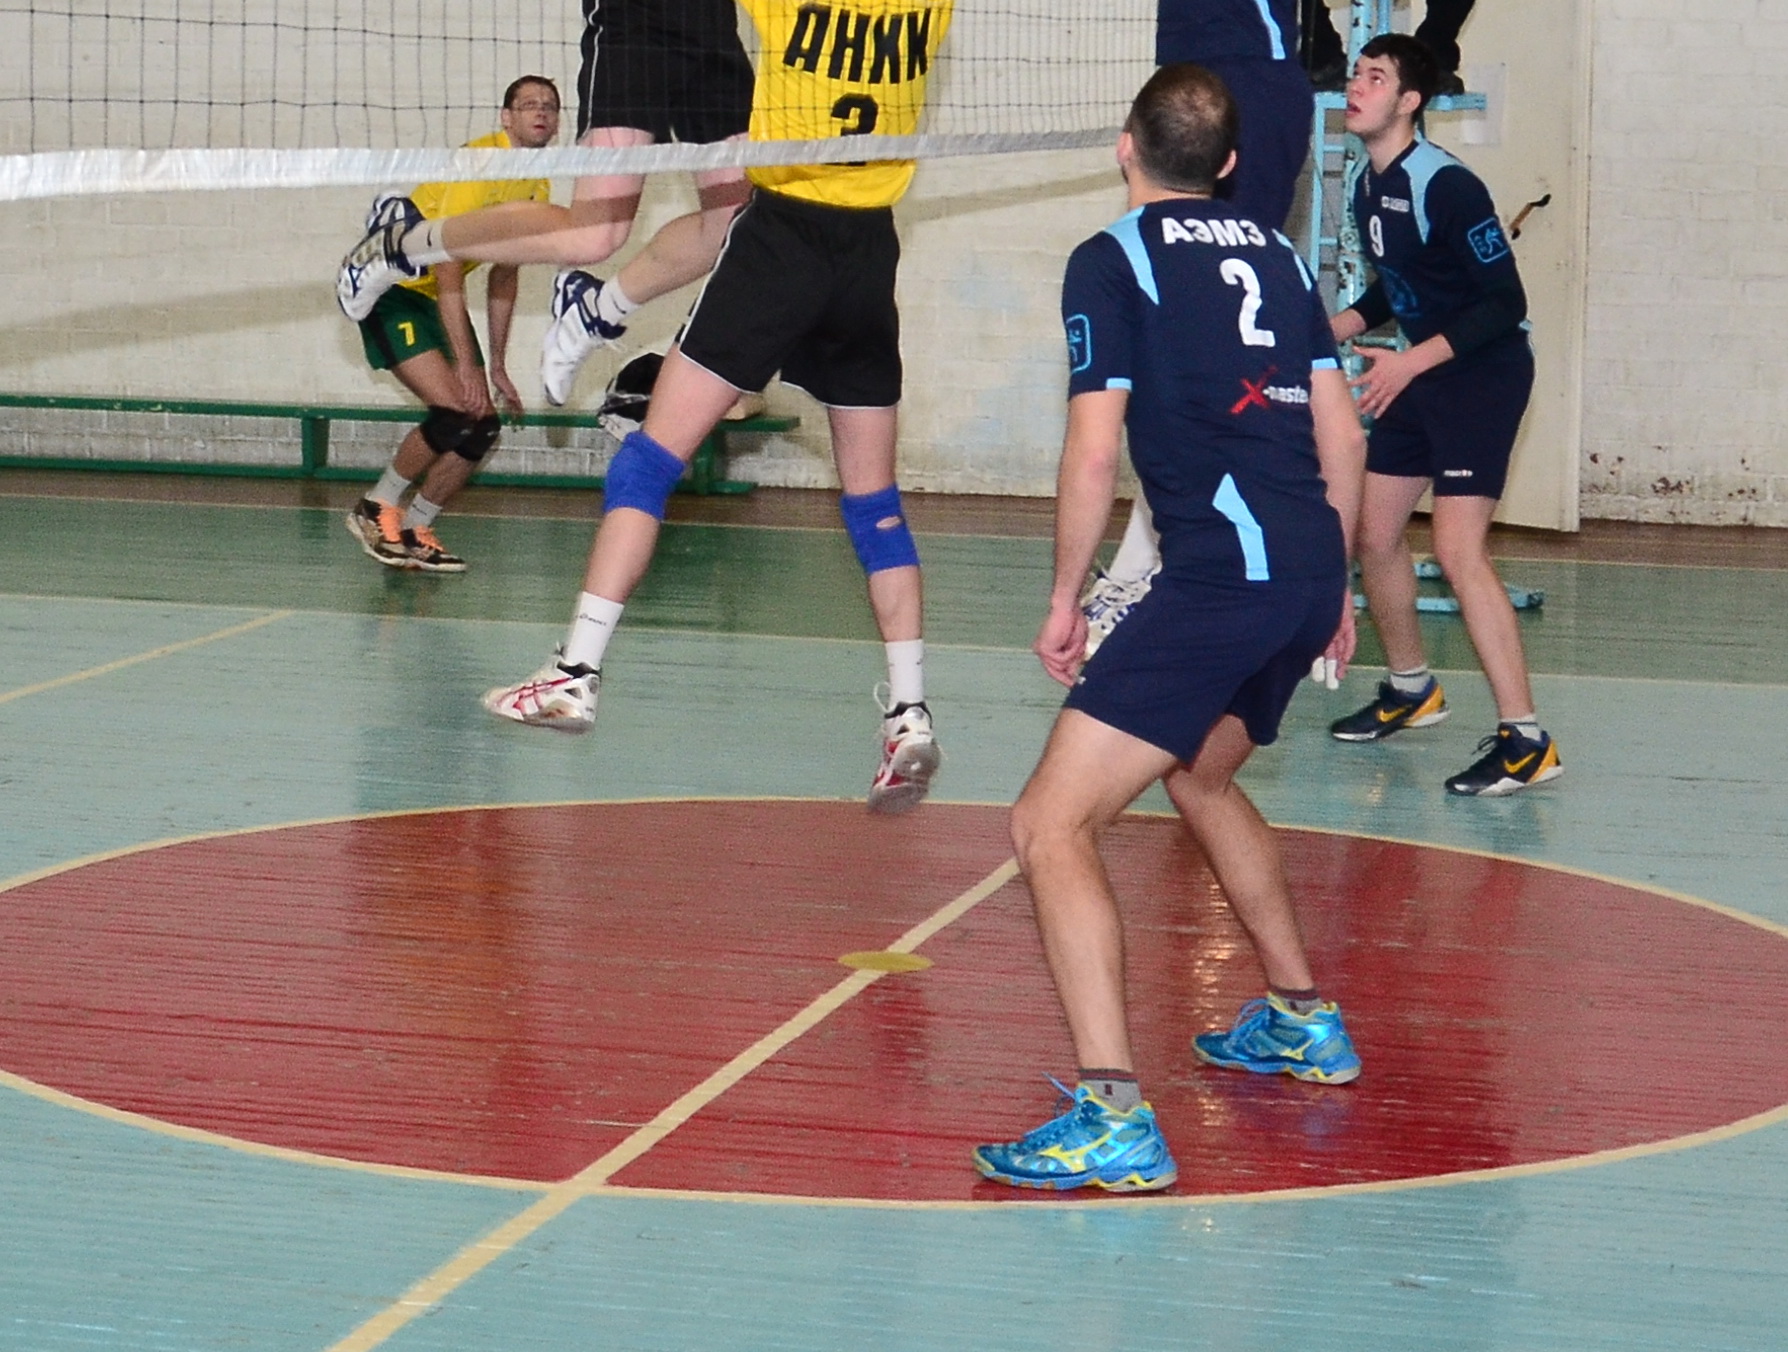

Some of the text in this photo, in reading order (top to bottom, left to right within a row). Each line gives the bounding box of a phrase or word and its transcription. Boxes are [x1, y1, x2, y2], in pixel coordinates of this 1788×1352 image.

[1161, 217, 1267, 247] АЭМЗ
[1369, 215, 1385, 257] 9
[1219, 257, 1276, 348] 2
